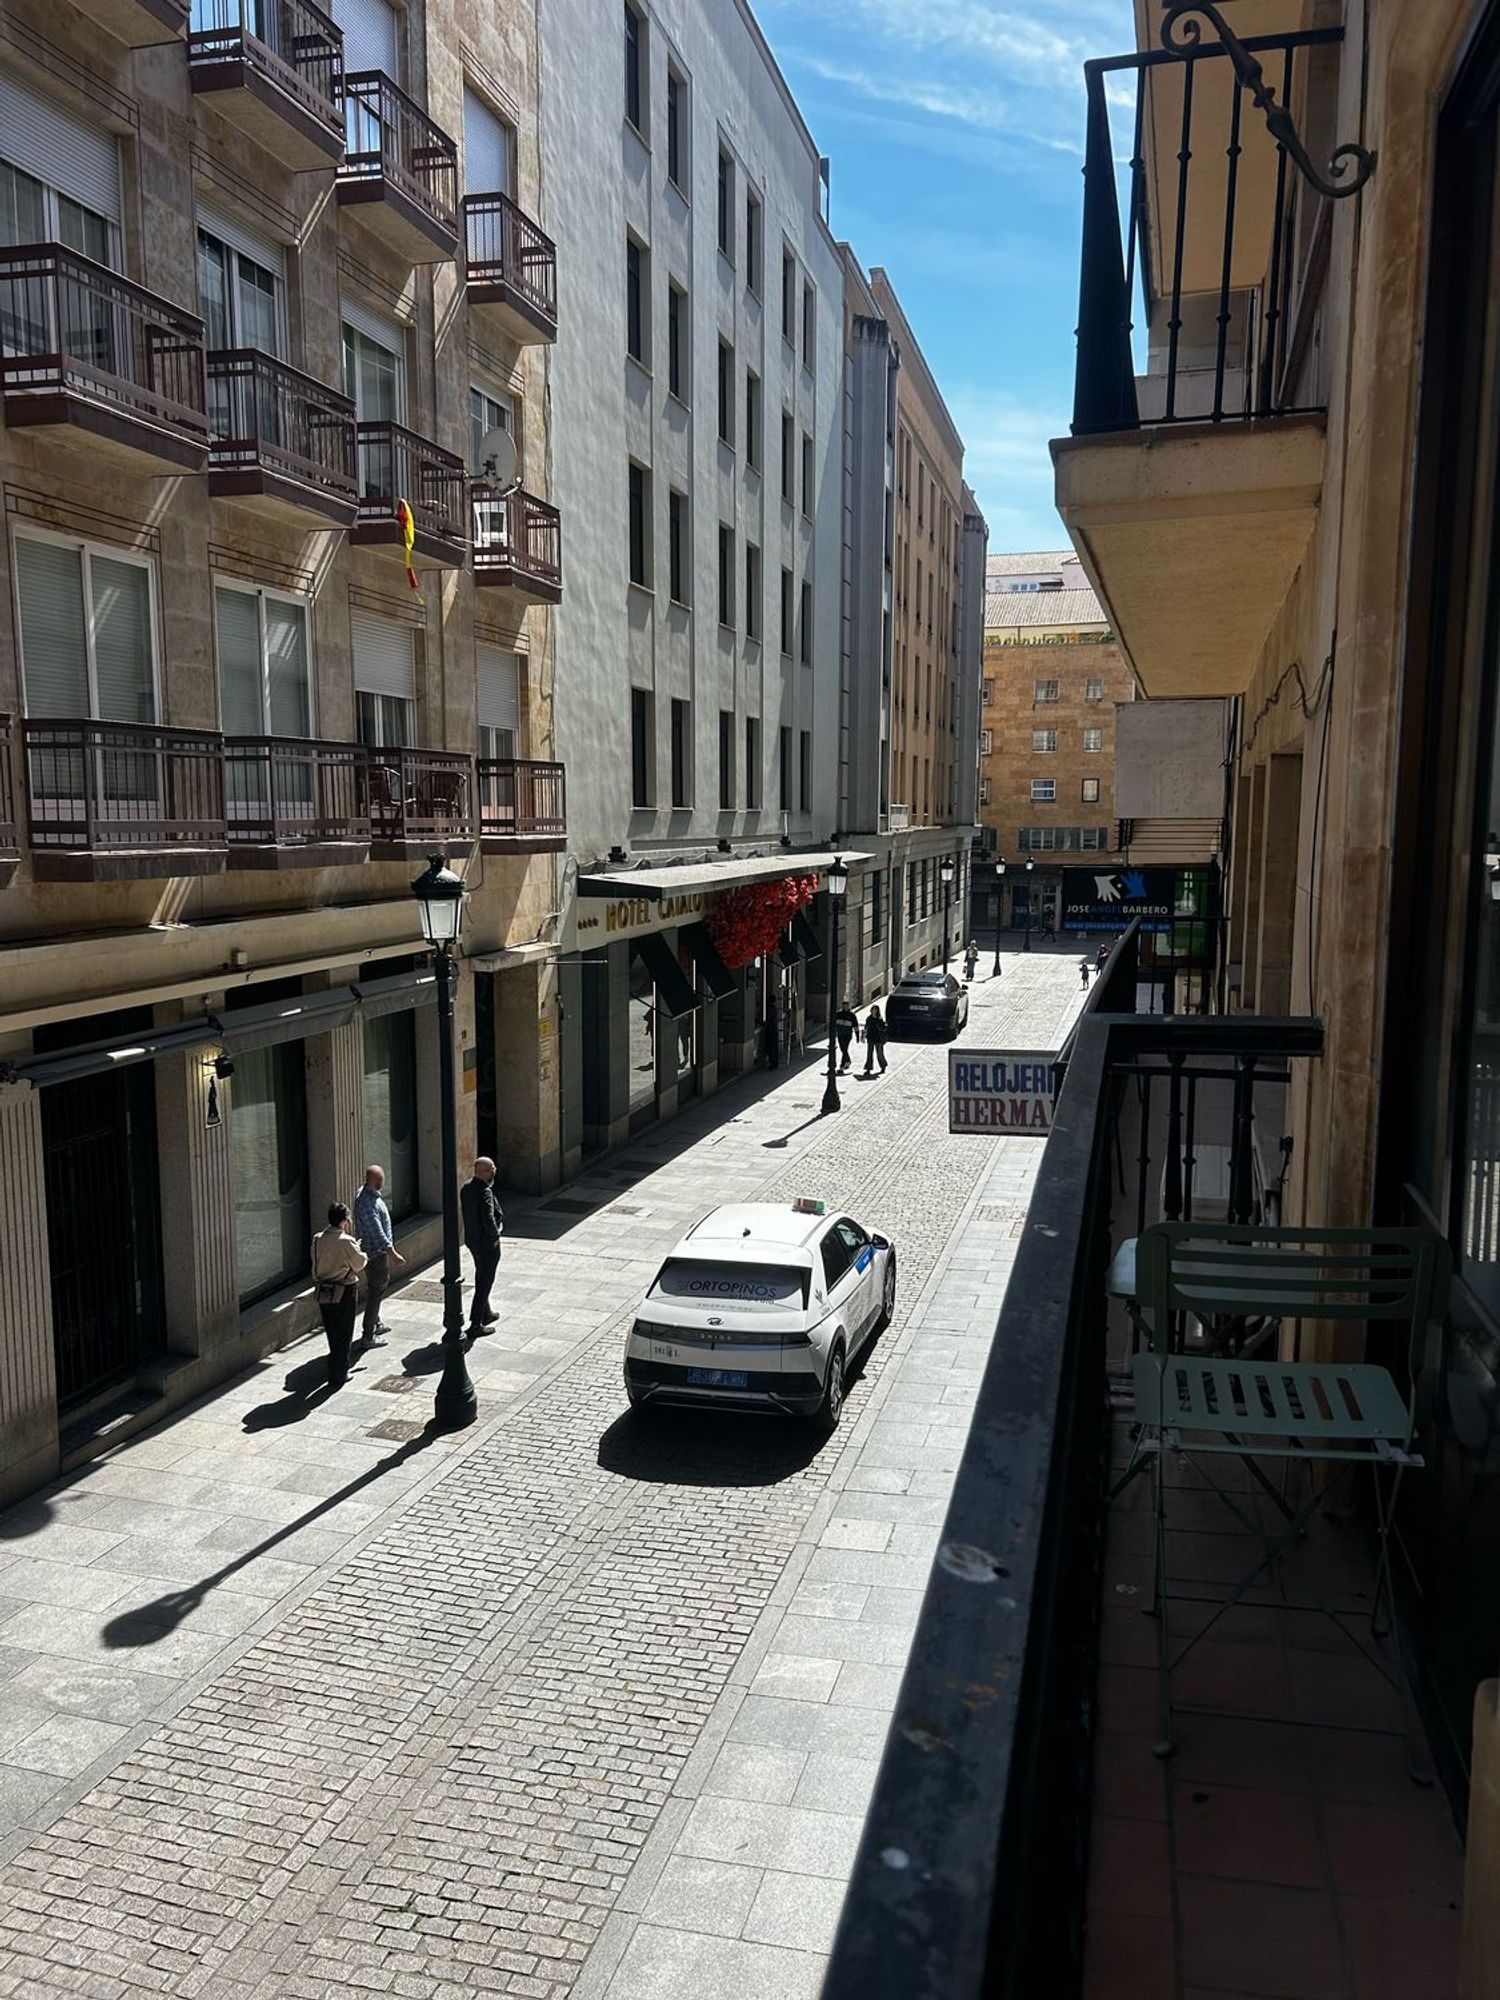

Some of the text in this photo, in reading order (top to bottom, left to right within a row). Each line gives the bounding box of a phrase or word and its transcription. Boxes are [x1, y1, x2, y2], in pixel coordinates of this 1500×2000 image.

[606, 897, 651, 932] HOTEL
[1066, 905, 1090, 914] JOSE
[1122, 905, 1168, 915] BARBERO
[952, 1097, 1055, 1127] HERMA
[689, 1280, 777, 1298] ORTOPINOS
